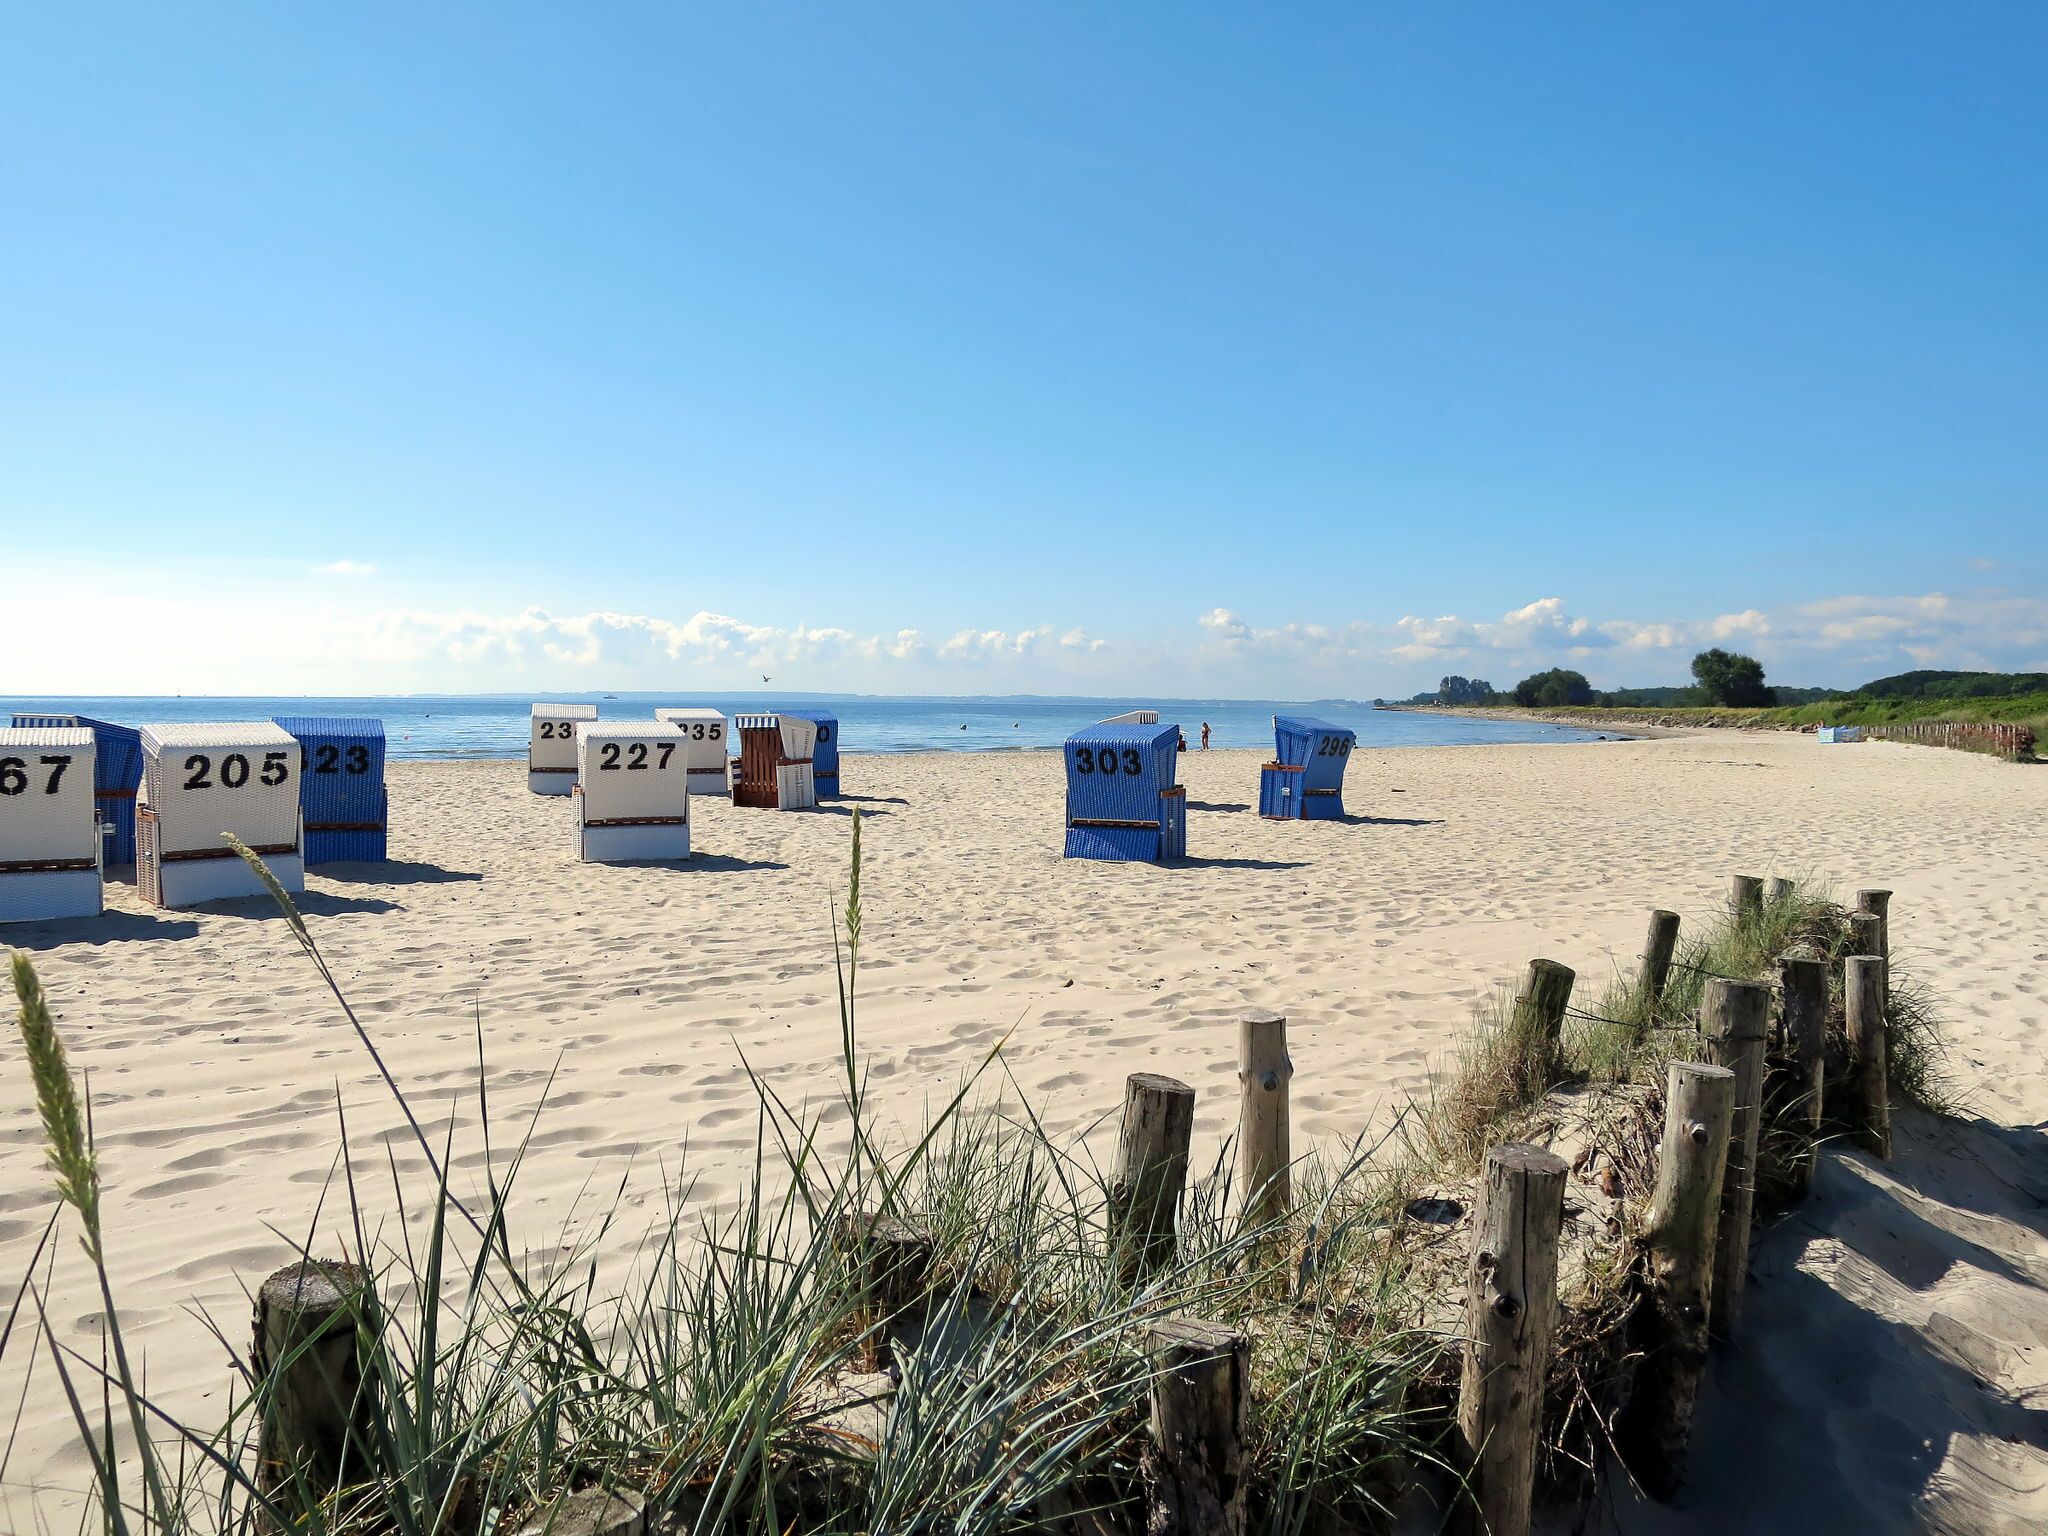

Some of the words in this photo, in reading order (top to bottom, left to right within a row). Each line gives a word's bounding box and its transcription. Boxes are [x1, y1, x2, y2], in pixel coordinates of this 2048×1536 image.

[541, 722, 577, 739] 23
[601, 743, 676, 770] 227
[1320, 736, 1350, 756] 296
[0, 756, 71, 795] 67
[184, 753, 288, 790] 205
[1076, 749, 1141, 776] 303
